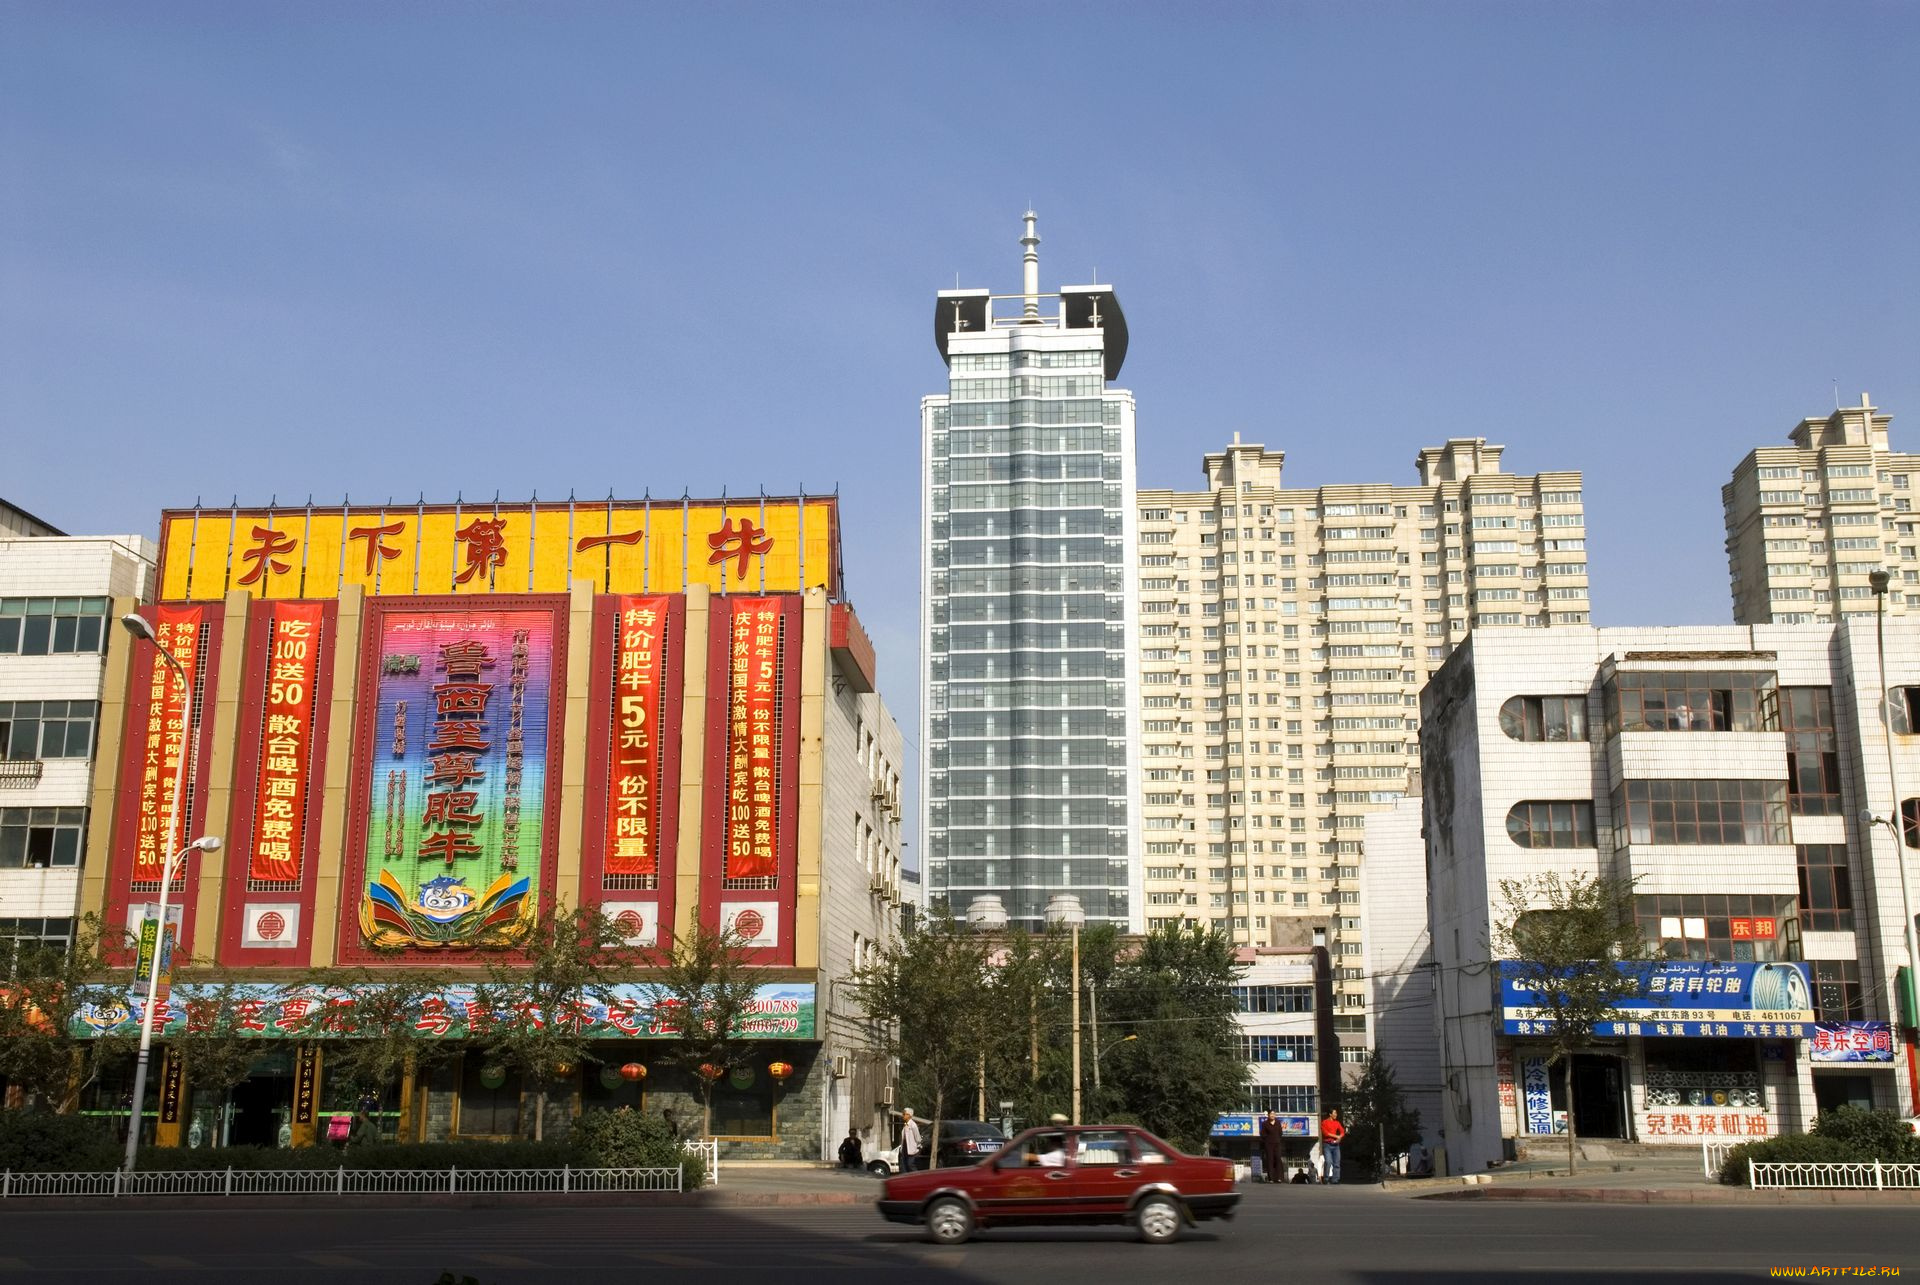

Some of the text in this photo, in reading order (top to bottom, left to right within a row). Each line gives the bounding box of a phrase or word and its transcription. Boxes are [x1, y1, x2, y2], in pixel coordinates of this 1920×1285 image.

[237, 517, 774, 584] 天下第一牛
[383, 654, 421, 673] 清真
[417, 639, 497, 865] 鲁西至尊肥牛
[613, 608, 657, 858] 特价肥牛5元一份不限量
[139, 925, 156, 977] 轻骑兵
[1813, 1031, 1891, 1051] 娱乐空间
[1646, 1114, 1768, 1135] 免费换机油
